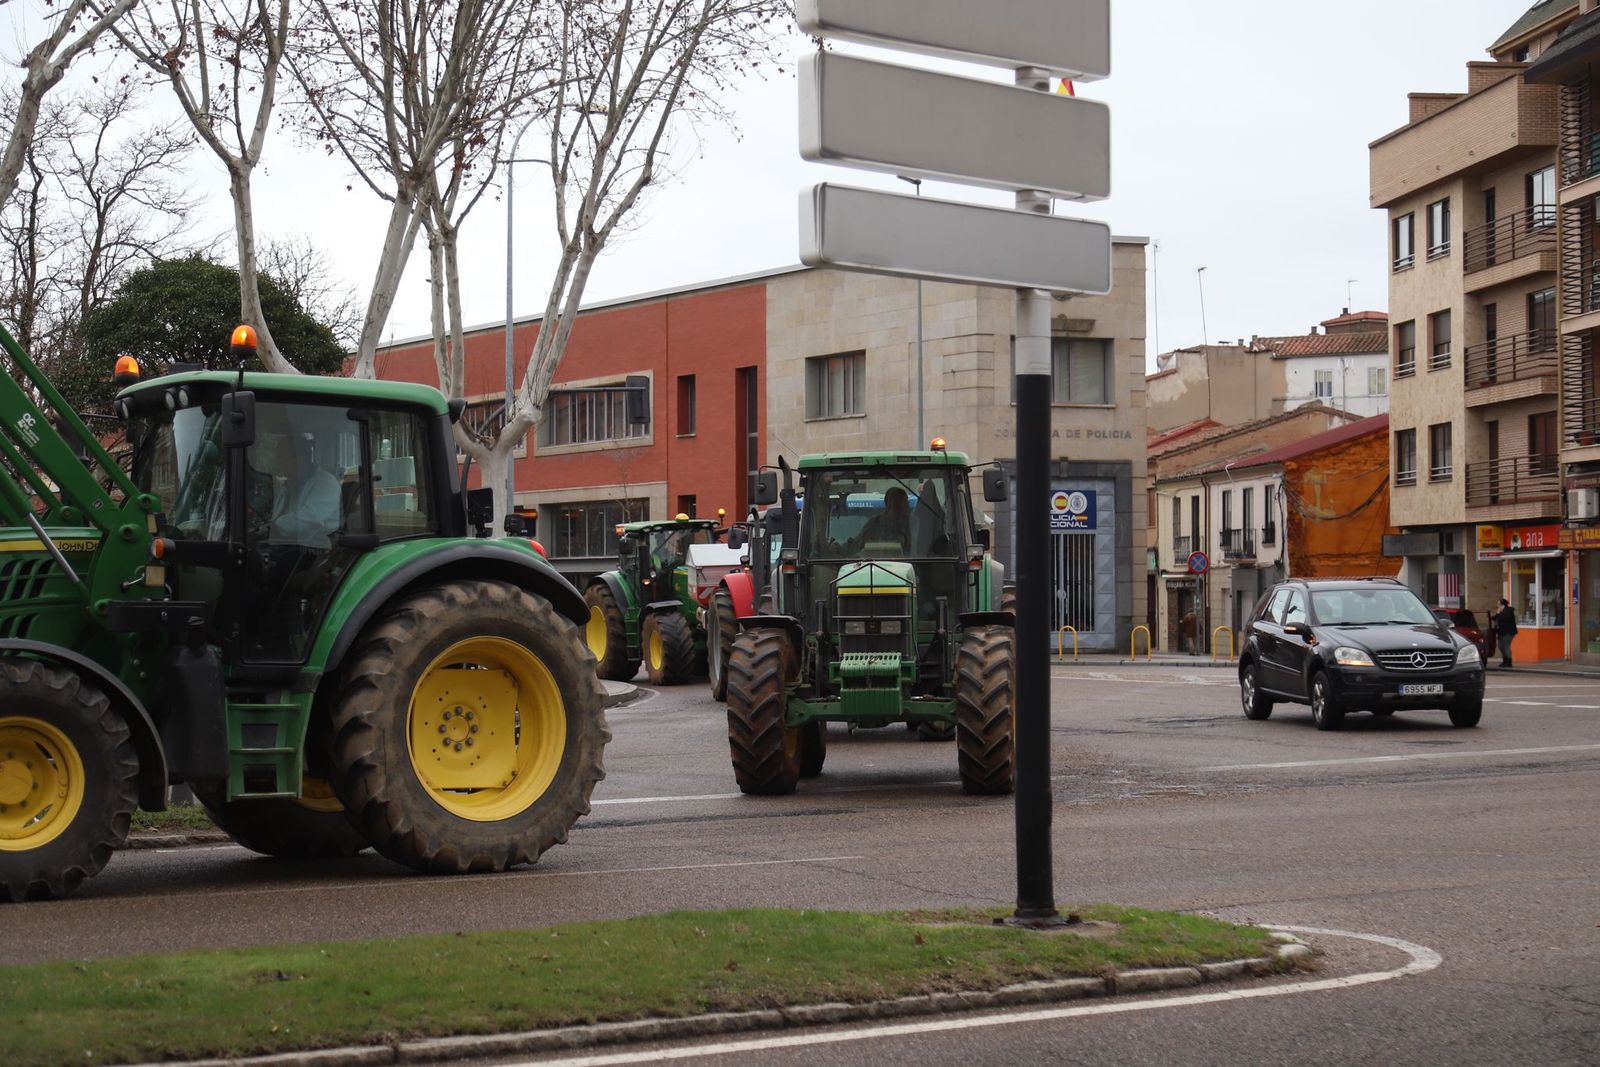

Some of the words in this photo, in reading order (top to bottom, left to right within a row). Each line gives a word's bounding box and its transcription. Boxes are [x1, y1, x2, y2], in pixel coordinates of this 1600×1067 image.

[1066, 429, 1081, 439] DE
[1086, 429, 1132, 439] POLICIA
[1526, 532, 1544, 547] ana
[58, 541, 85, 550] JOHN
